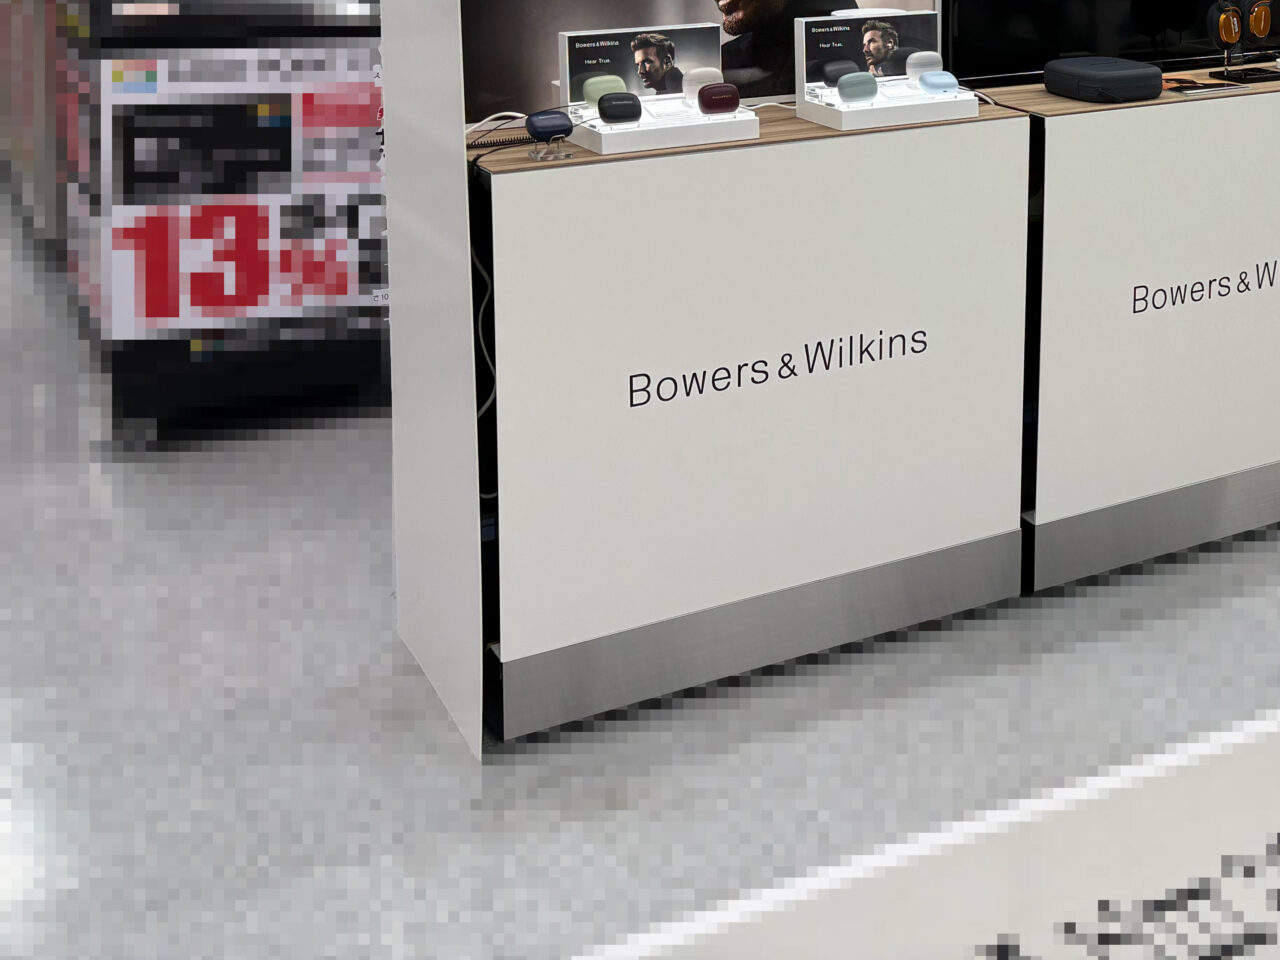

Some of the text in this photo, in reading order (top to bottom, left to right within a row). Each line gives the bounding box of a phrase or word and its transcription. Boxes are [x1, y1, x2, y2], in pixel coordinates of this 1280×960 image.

[1132, 276, 1231, 314] Bowers
[1236, 271, 1251, 294] &
[629, 329, 928, 408] Bowers & Wilkins
